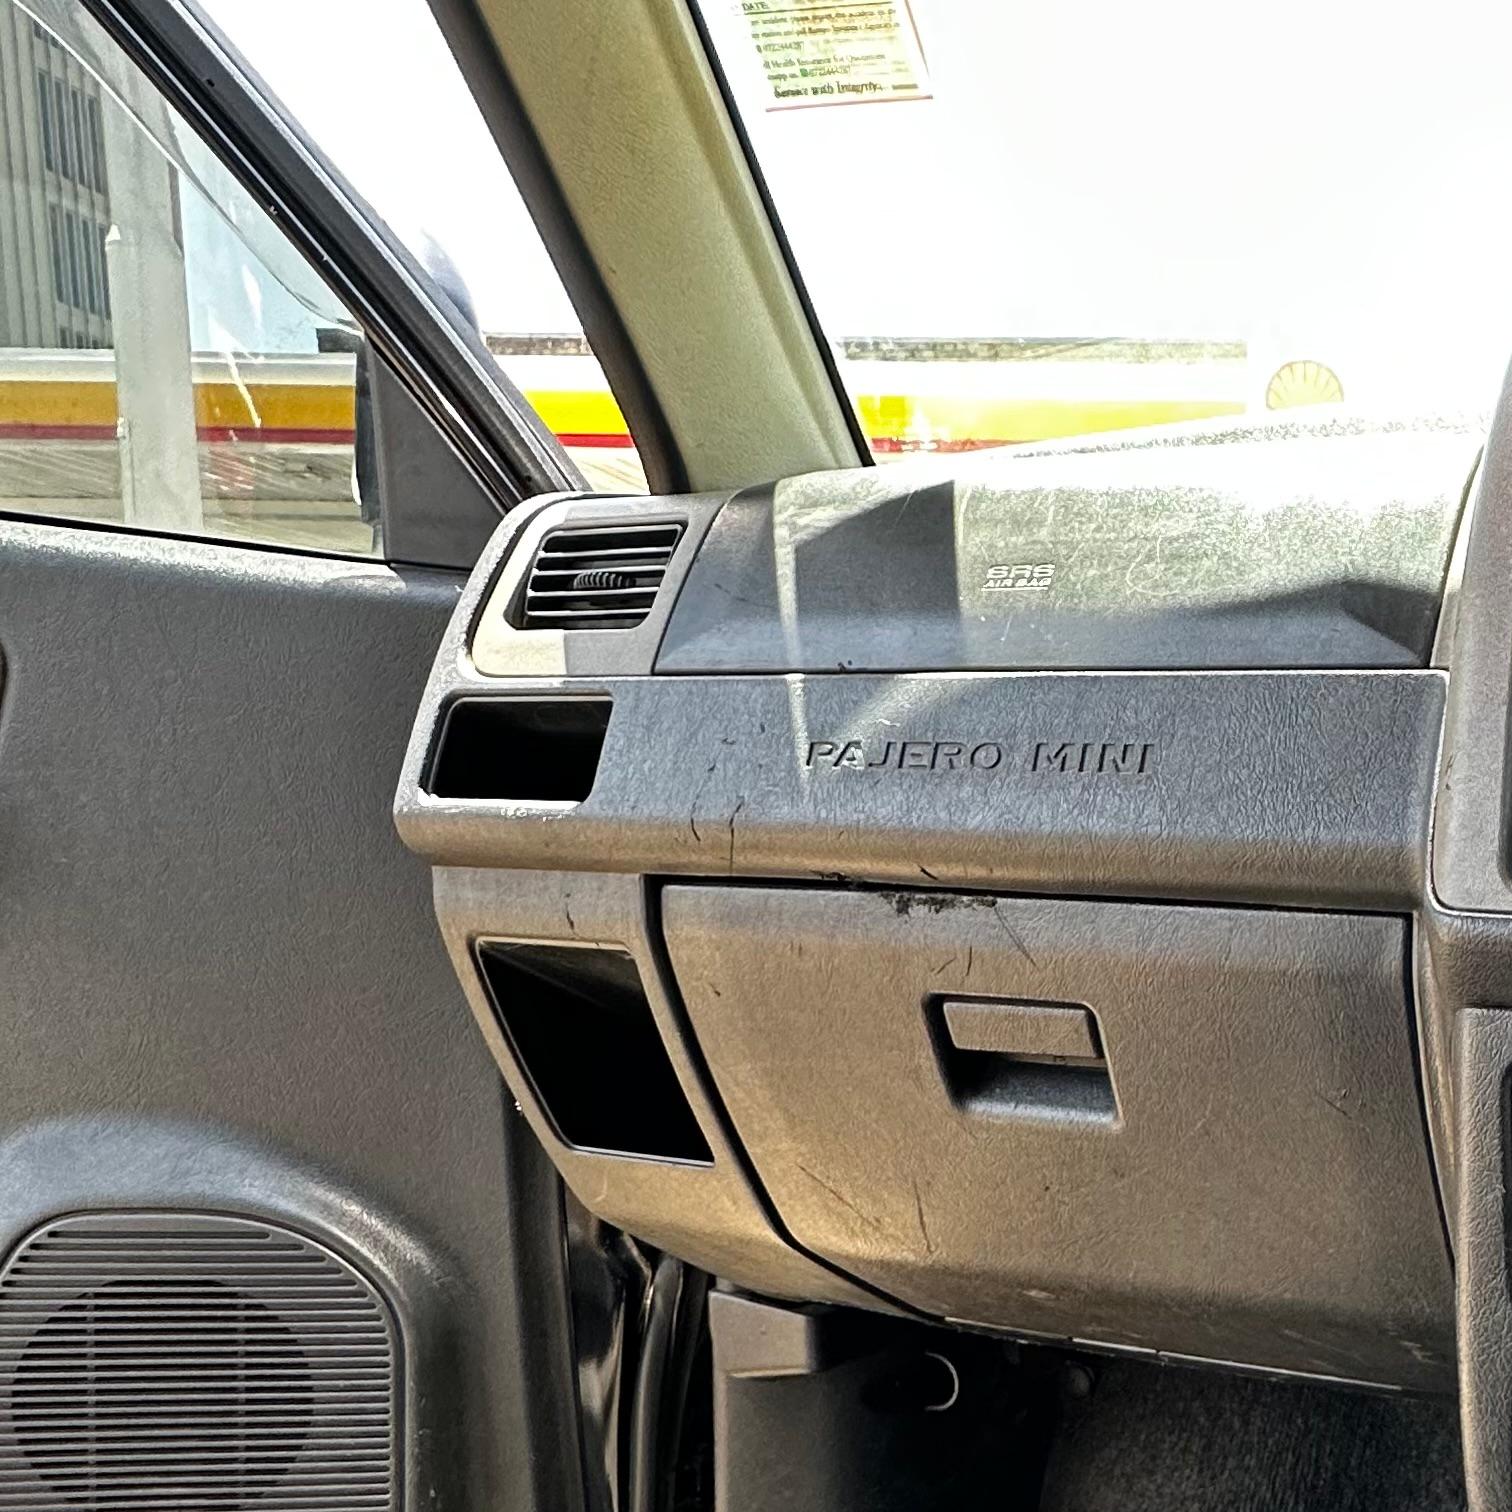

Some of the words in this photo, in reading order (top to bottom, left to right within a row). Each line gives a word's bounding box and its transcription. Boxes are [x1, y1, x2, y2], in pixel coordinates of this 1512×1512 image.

[986, 563, 1055, 579] SRS
[983, 579, 1013, 588] AIR
[1015, 577, 1052, 588] BAG
[804, 739, 1003, 772] PAJERO
[1030, 741, 1156, 775] MINI
